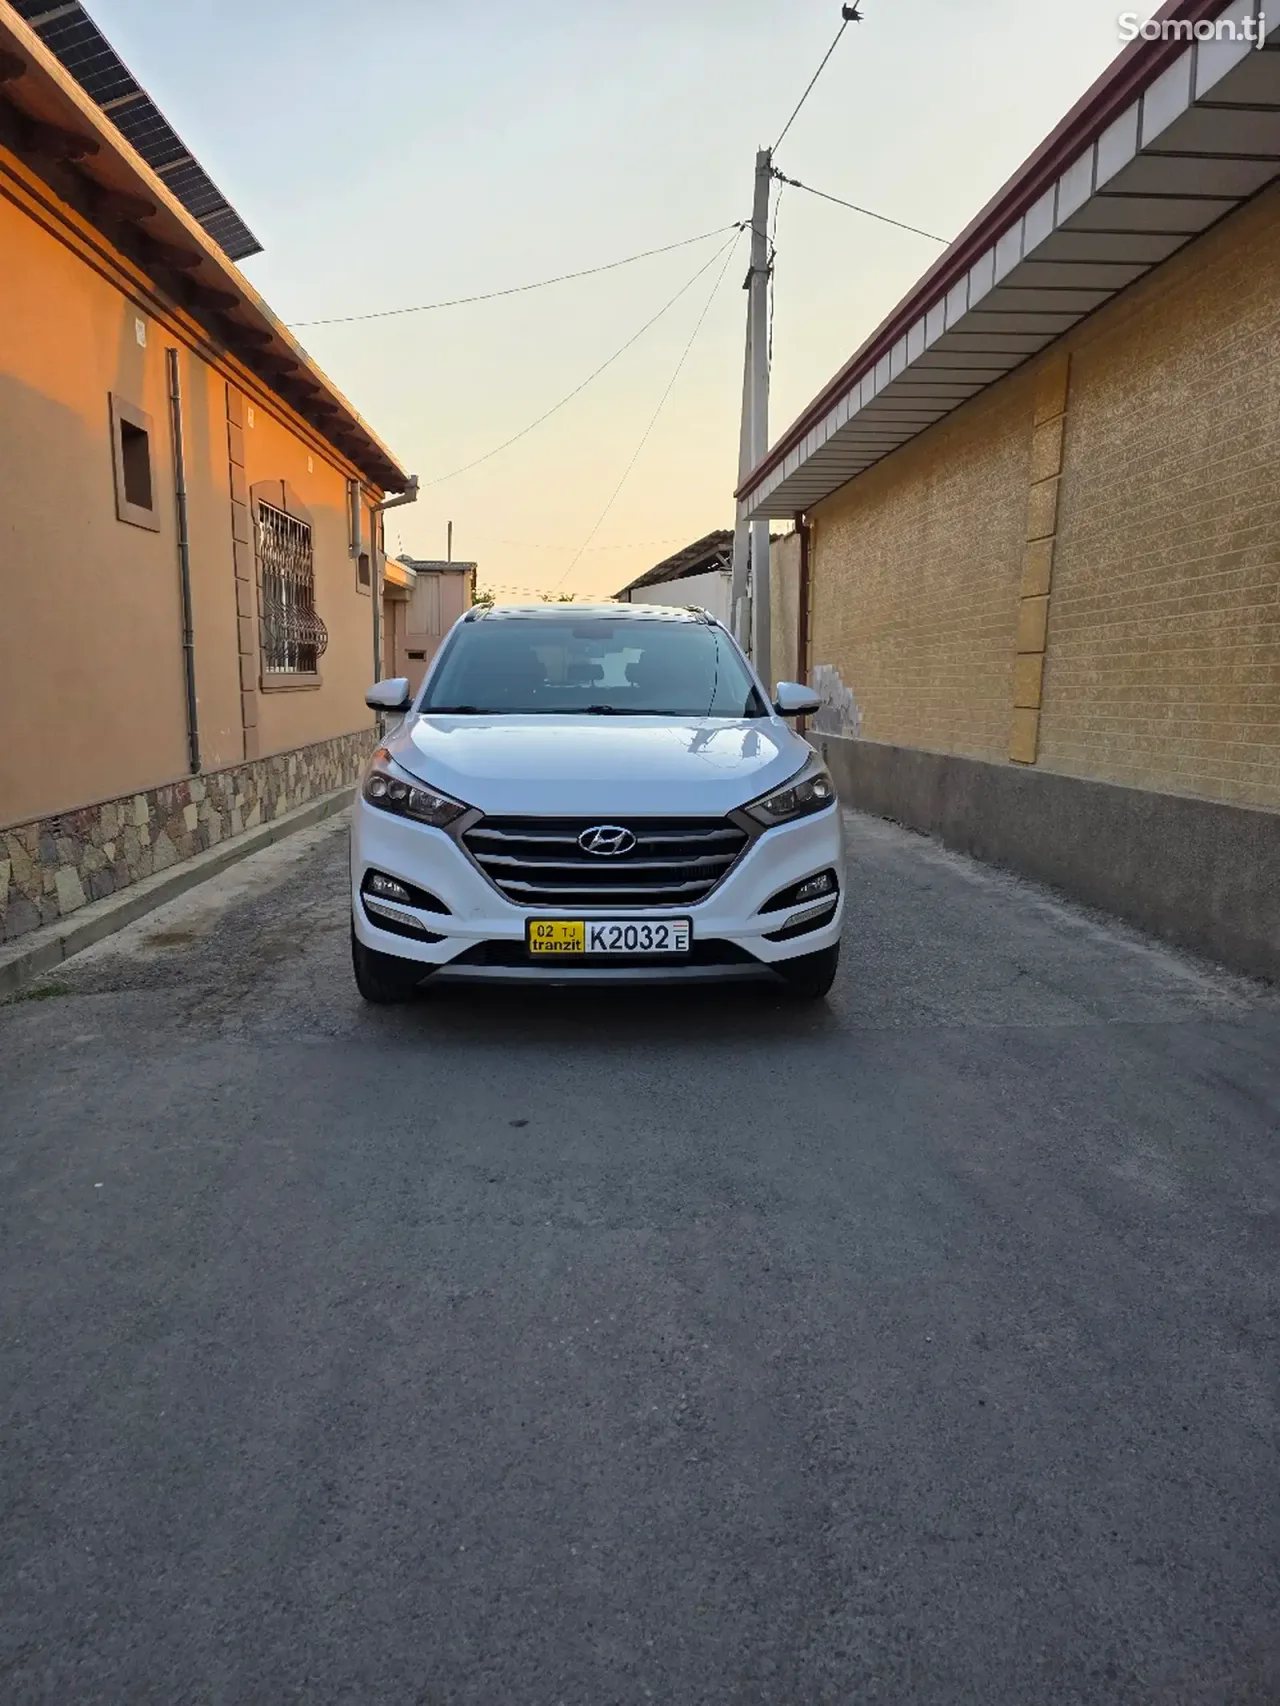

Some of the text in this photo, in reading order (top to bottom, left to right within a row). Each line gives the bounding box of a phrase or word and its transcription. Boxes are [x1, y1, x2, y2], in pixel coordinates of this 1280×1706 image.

[537, 925, 576, 938] 02 TJ
[590, 925, 669, 950] K2032
[533, 939, 581, 951] tranzit
[675, 935, 687, 950] E
